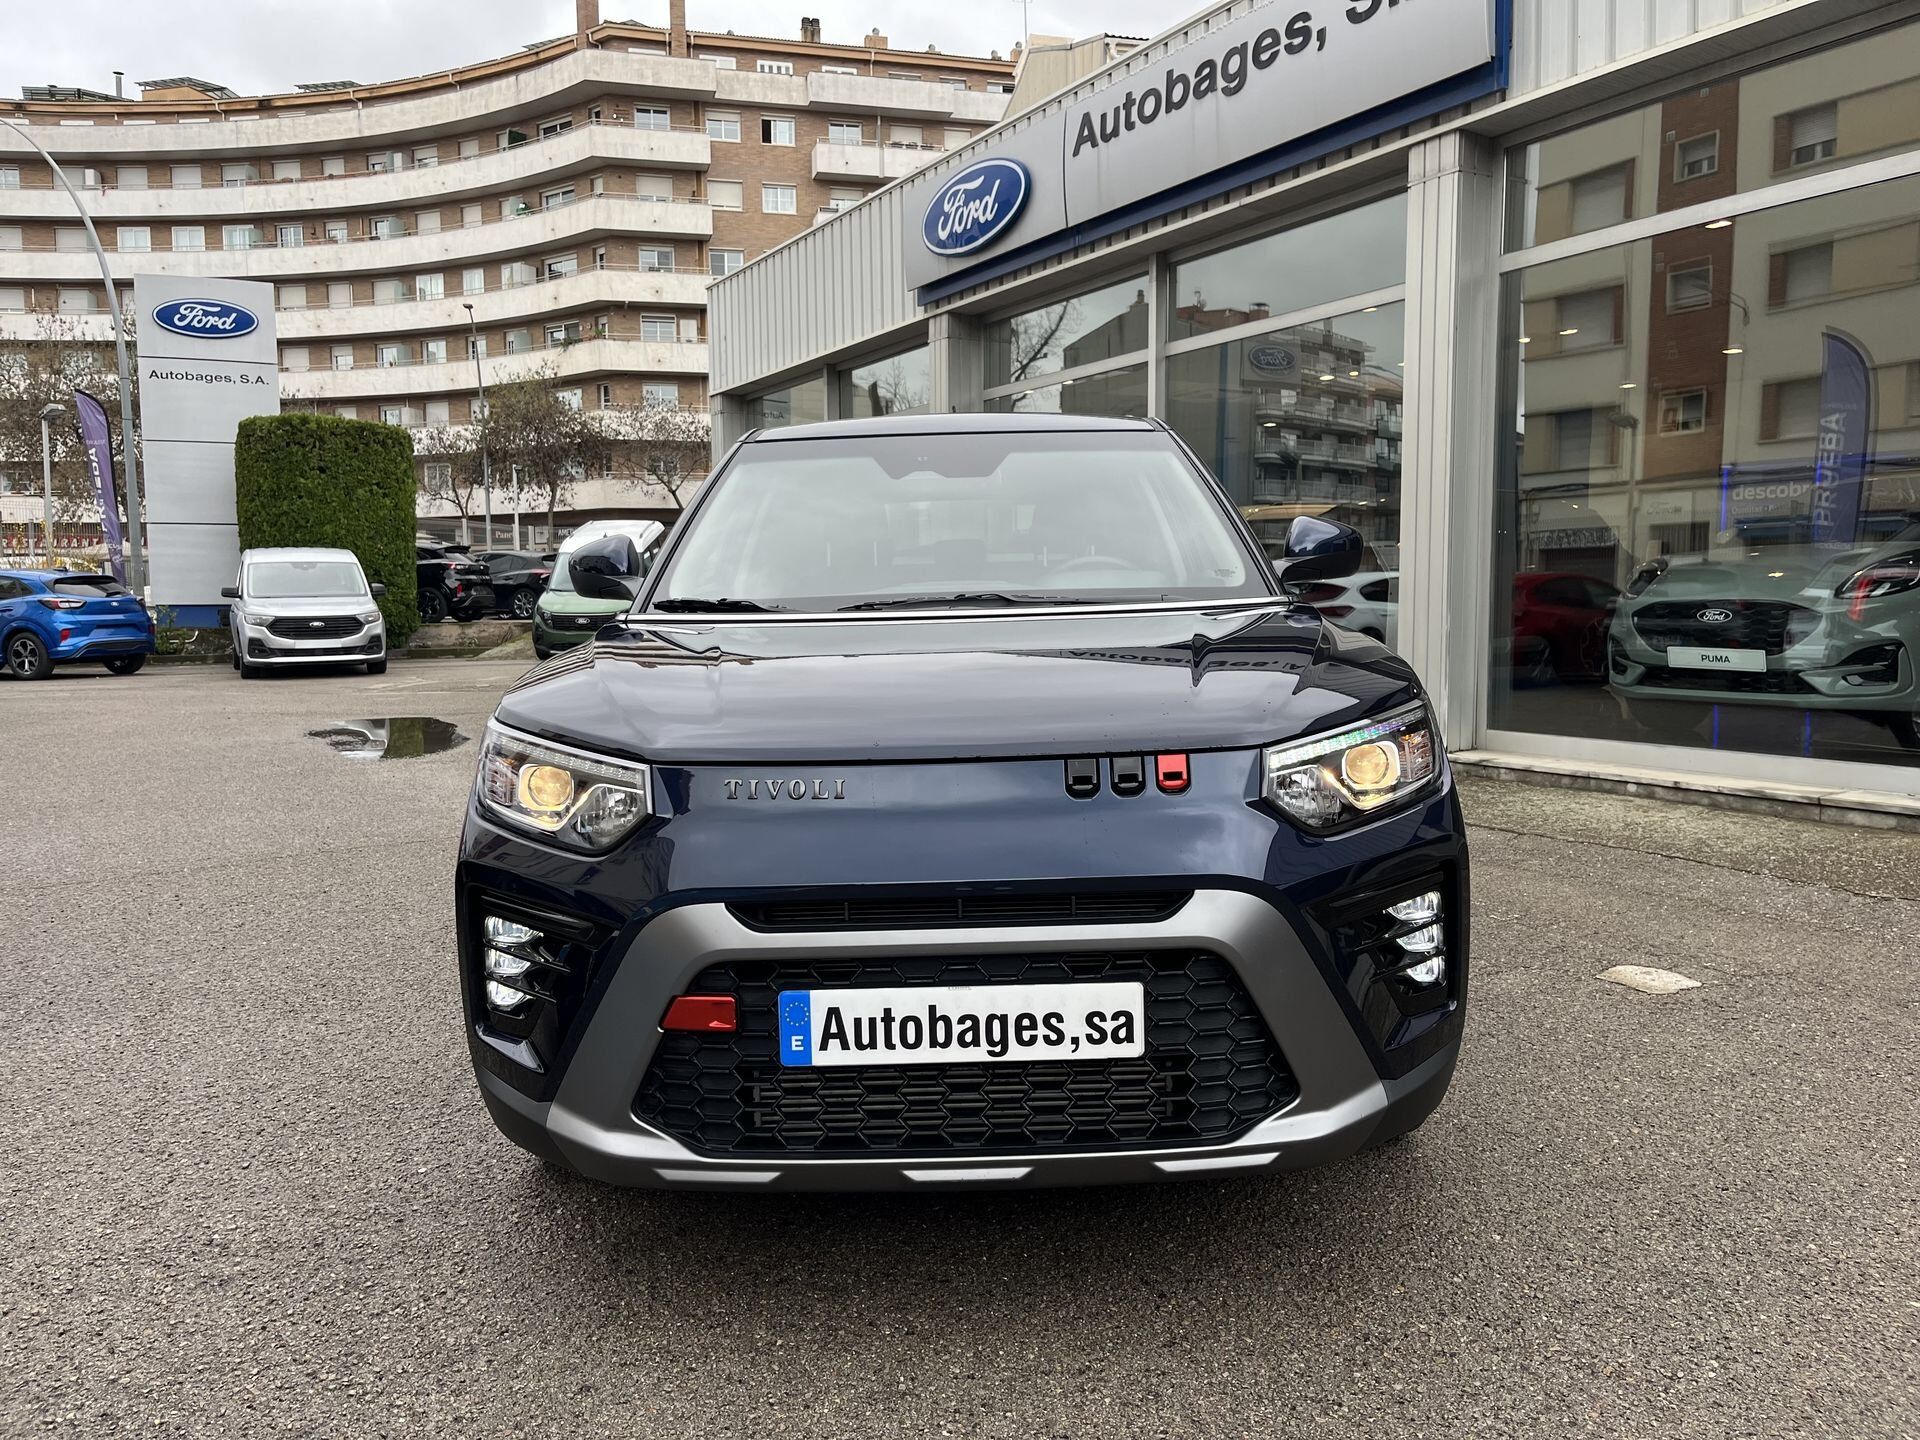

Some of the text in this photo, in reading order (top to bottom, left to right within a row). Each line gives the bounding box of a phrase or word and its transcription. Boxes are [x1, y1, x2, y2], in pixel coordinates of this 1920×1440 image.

[1071, 11, 1328, 158] Autobages,
[937, 174, 1001, 241] Ford
[173, 303, 238, 330] Ford
[149, 369, 271, 386] Autobages, S.A.
[1812, 412, 1848, 527] PRUEBA
[1702, 610, 1726, 621] Ford
[1700, 654, 1731, 664] PUMA
[724, 778, 847, 800] TIVOLI
[790, 1004, 1136, 1058] E Autobages,sa
